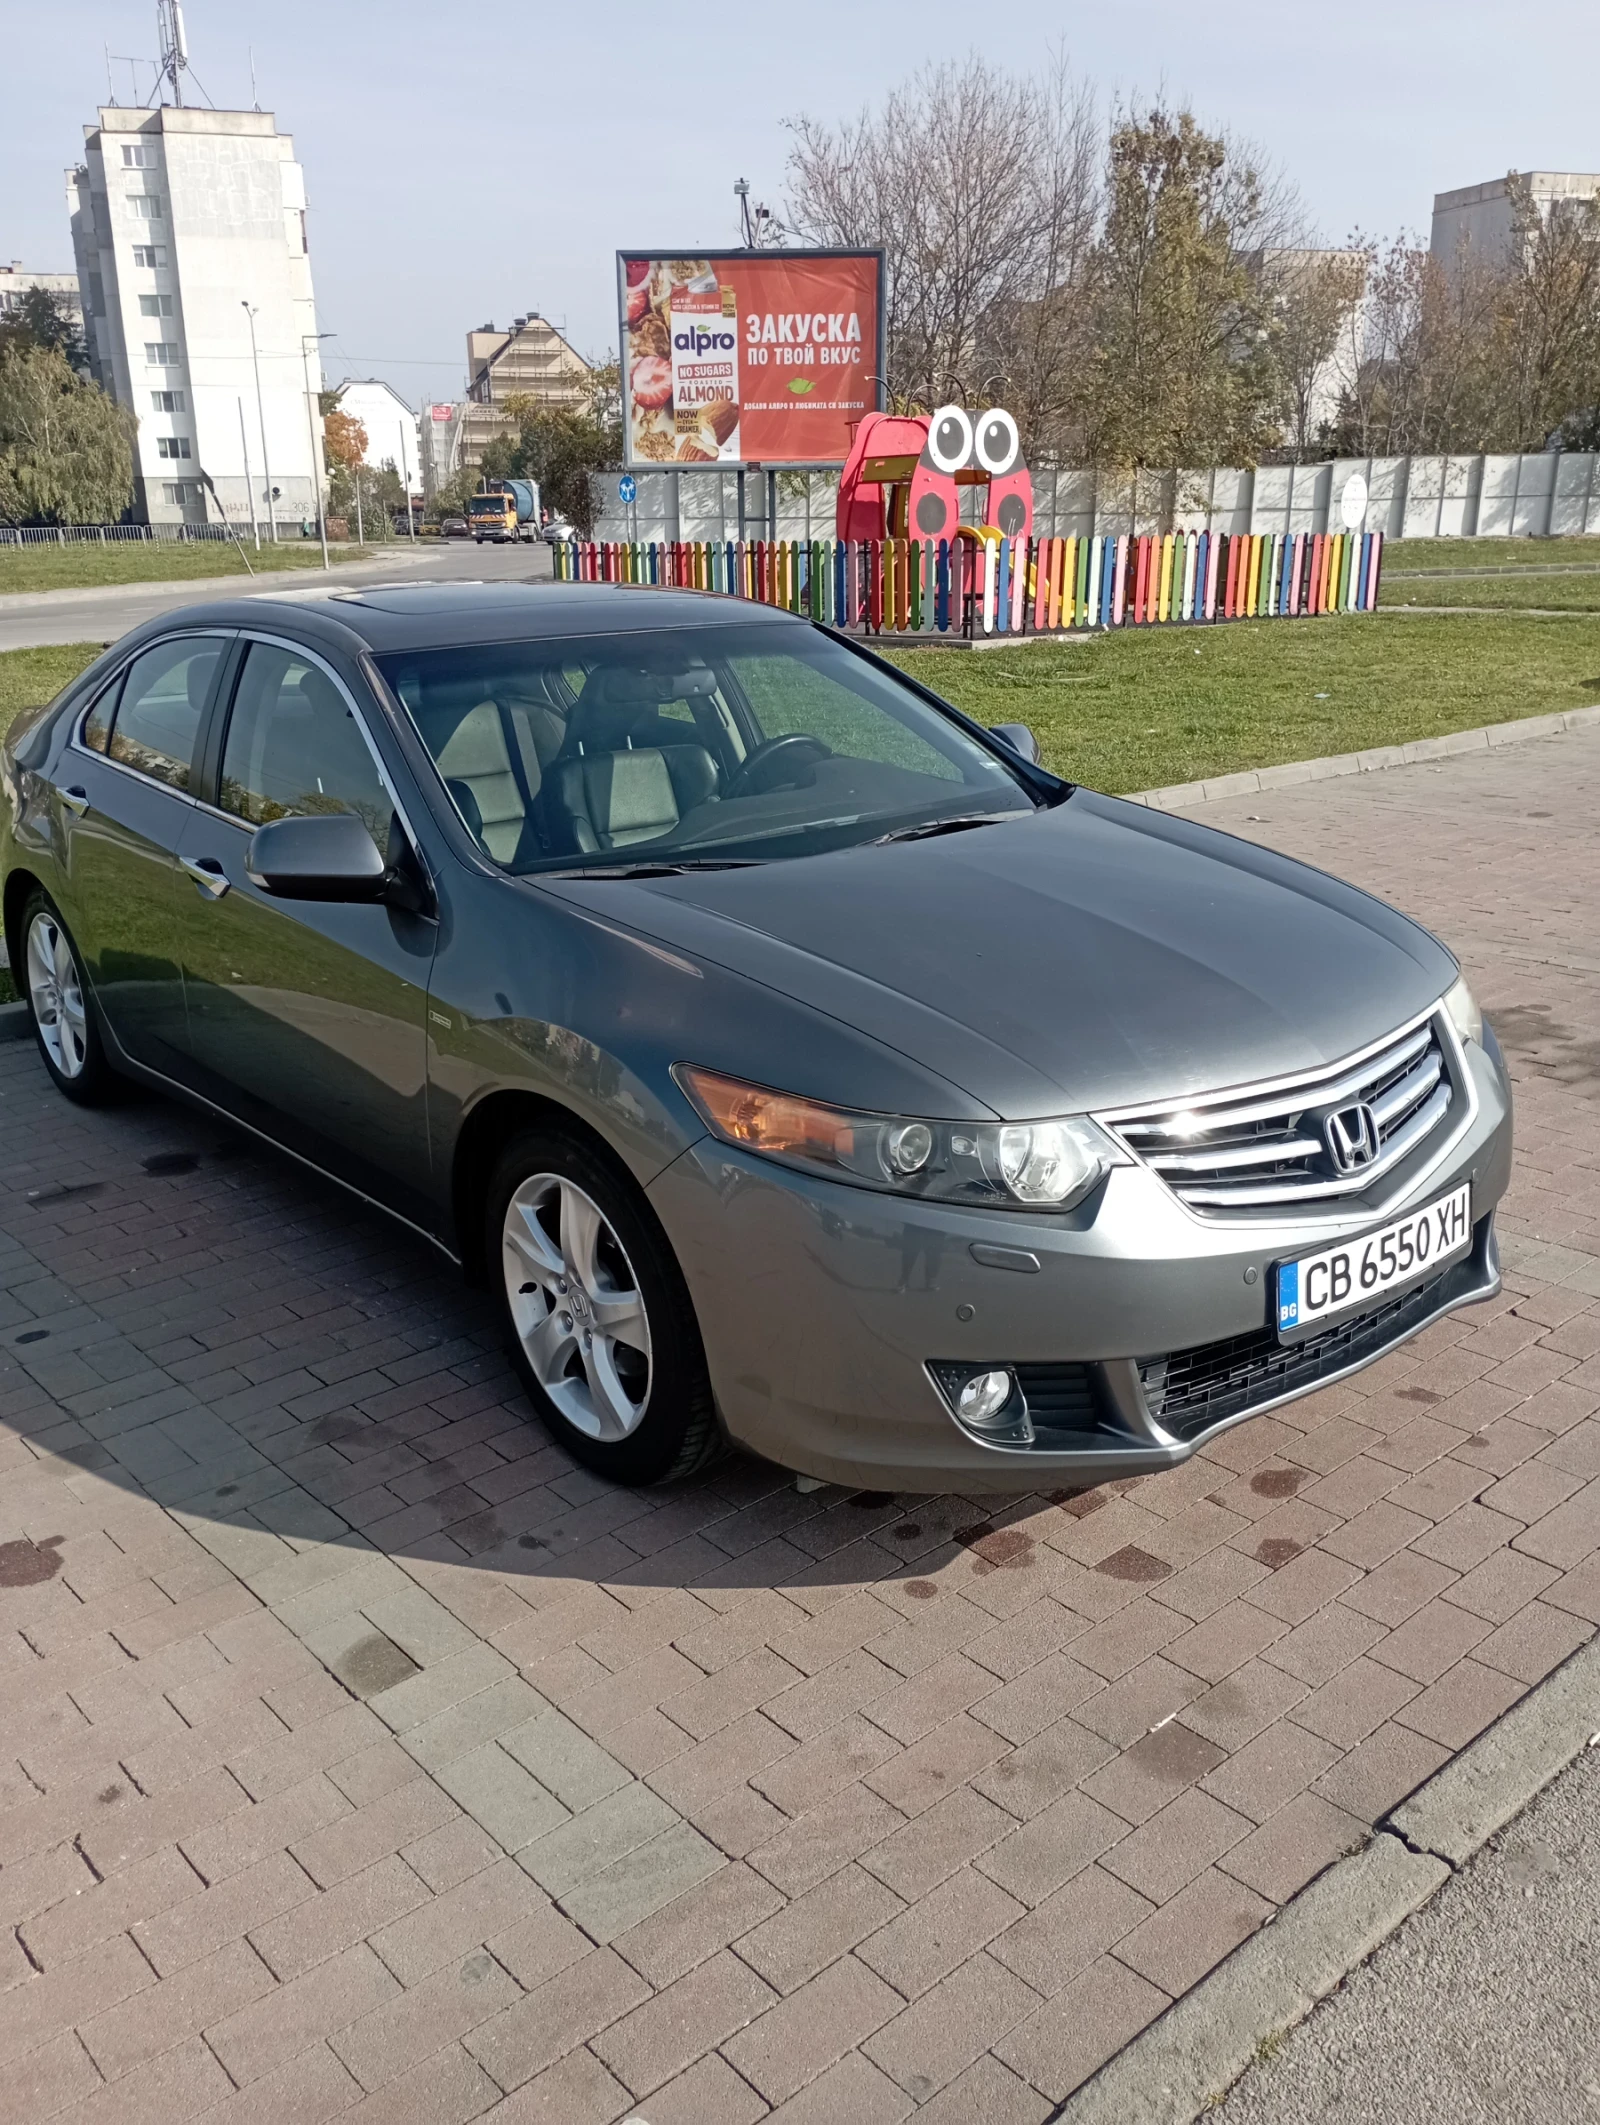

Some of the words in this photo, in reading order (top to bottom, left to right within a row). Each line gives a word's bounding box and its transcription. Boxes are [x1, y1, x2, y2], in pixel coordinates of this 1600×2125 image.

[745, 312, 861, 343] ЗАКУСКА
[674, 325, 735, 357] alpro
[747, 347, 768, 366] ПО
[774, 343, 814, 365] ТВОЙ
[820, 347, 861, 365] ВКУС
[679, 367, 693, 378] NO
[694, 364, 731, 377] SUGARS
[678, 385, 734, 402] ALMOND
[837, 401, 865, 409] ЗАКУСКА
[676, 410, 698, 419] NOW
[291, 502, 310, 513] 306
[1305, 1253, 1352, 1311] CB
[1360, 1216, 1430, 1289] 6550
[1436, 1192, 1466, 1253] XH
[1280, 1302, 1297, 1321] BG
